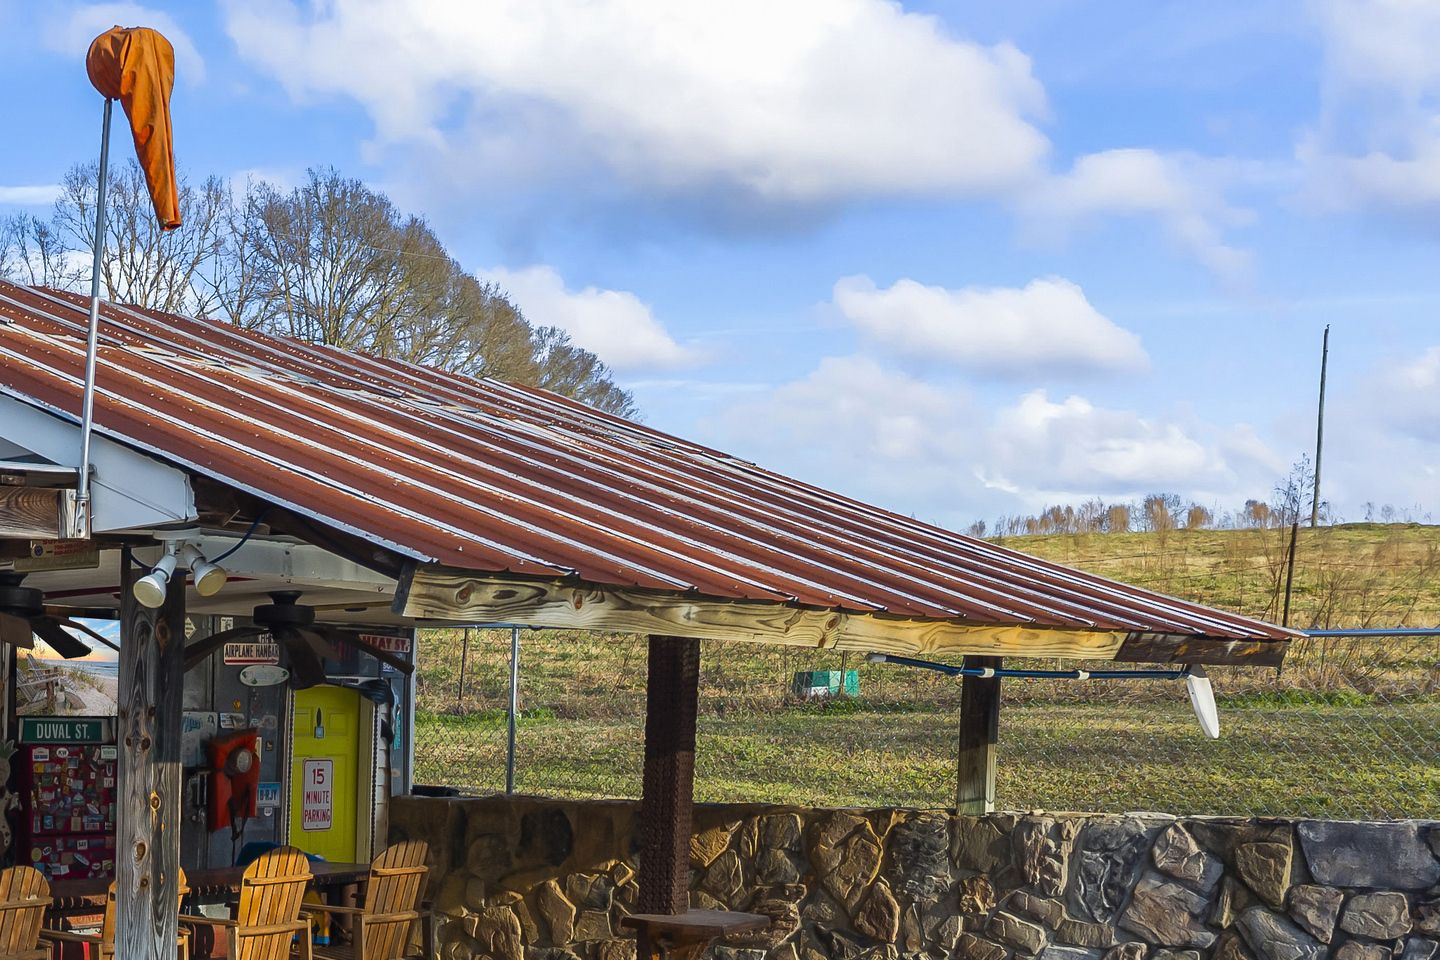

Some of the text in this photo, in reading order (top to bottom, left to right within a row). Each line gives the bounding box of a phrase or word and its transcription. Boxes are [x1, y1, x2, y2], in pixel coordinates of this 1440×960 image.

[224, 644, 279, 658] AIRPLANE HANGAR
[36, 723, 90, 739] DUVAL ST.
[312, 768, 325, 785] 15
[305, 790, 330, 804] MINUTE
[304, 808, 330, 823] PARKING
